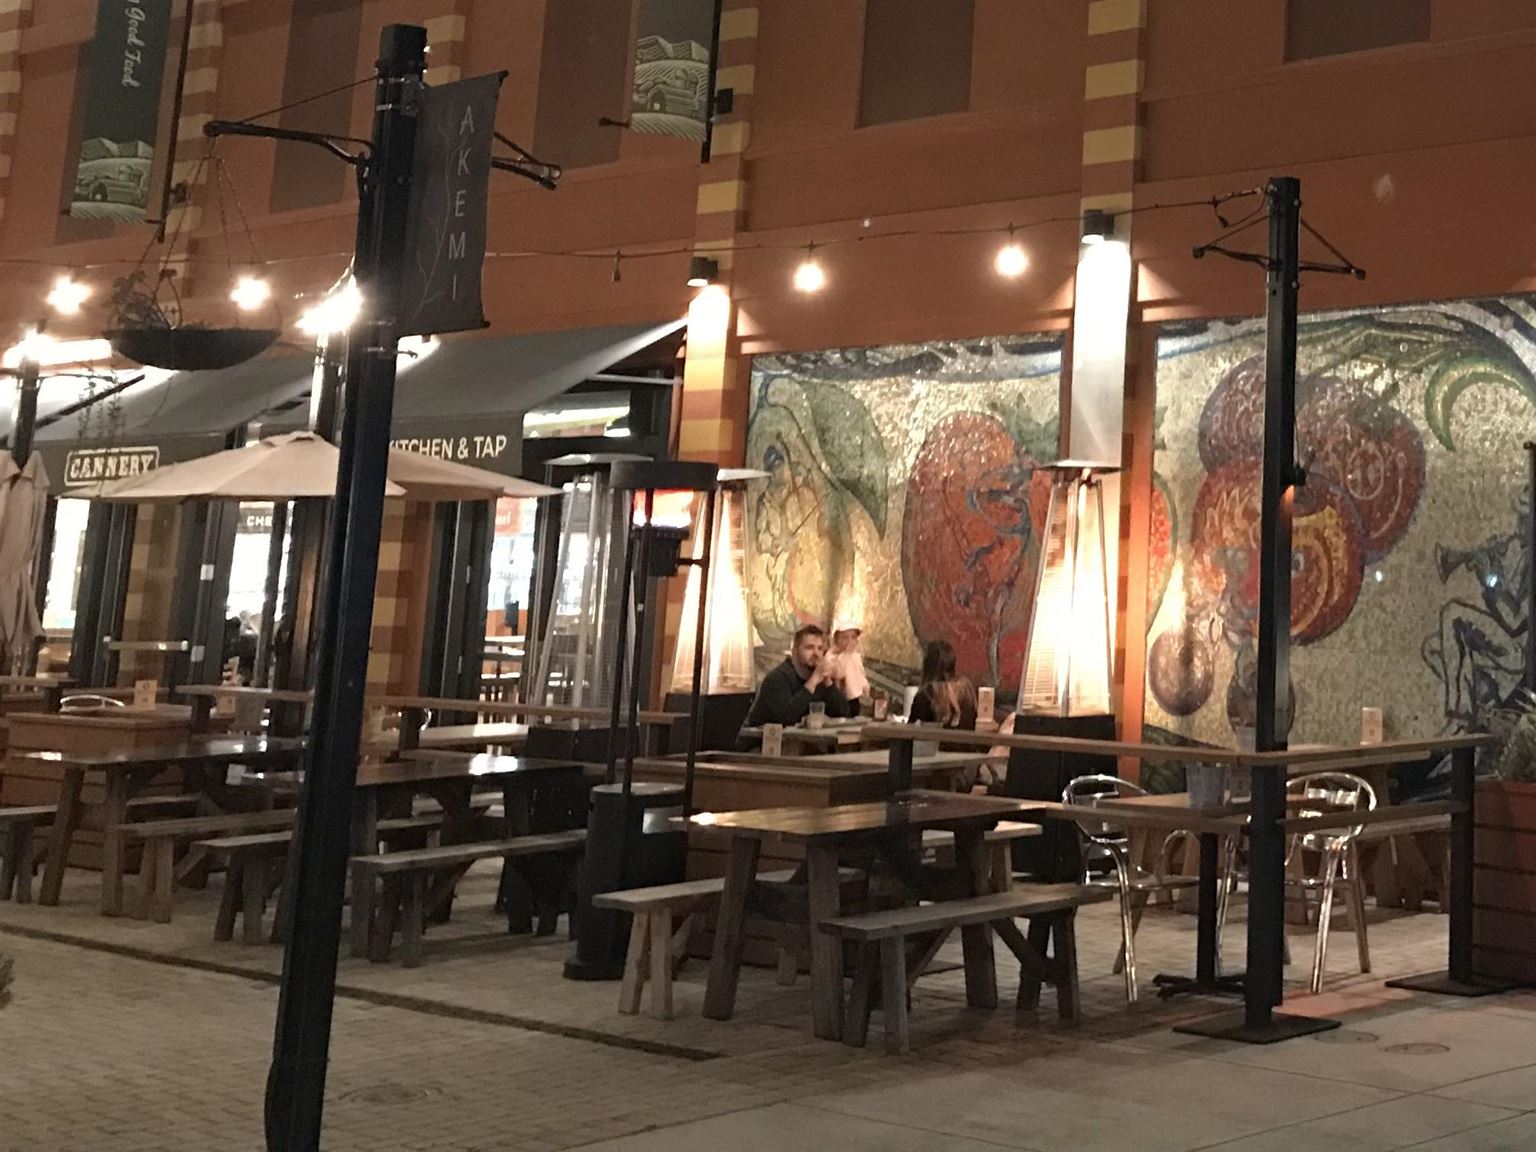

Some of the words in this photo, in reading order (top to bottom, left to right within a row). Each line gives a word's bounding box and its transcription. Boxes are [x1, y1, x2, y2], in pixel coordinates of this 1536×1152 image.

[125, 7, 145, 46] Good
[448, 104, 475, 301] AKEMI
[457, 437, 469, 460] &
[473, 434, 508, 459] TAP
[69, 453, 154, 479] CANNERY
